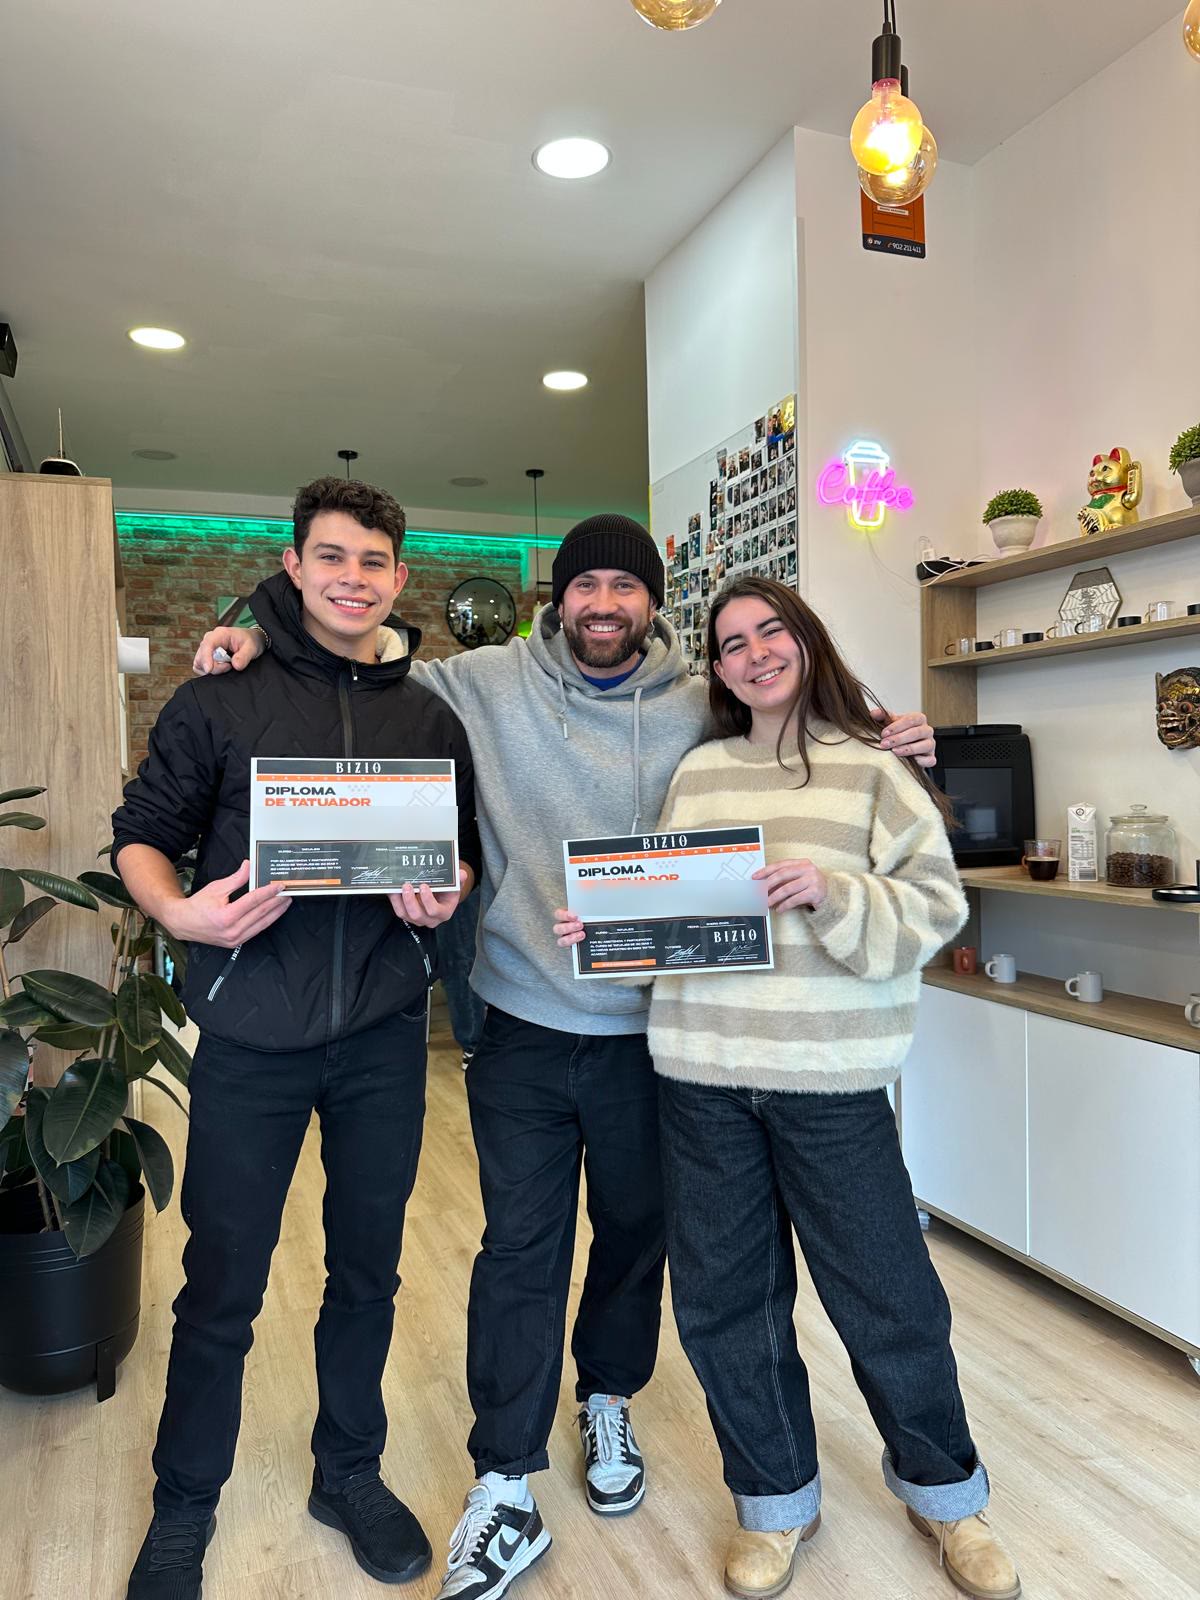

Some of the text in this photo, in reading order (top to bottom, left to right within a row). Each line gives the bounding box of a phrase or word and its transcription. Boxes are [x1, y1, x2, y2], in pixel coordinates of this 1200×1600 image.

[819, 463, 914, 519] Coffee
[336, 762, 382, 773] BIZIO
[265, 786, 336, 796] DIPLOMA
[265, 798, 371, 806] DE TATUADOR
[642, 834, 688, 850] BIZIO
[402, 854, 445, 866] BIZIO
[578, 864, 645, 878] DIPLOMA
[714, 928, 757, 943] BIZIO
